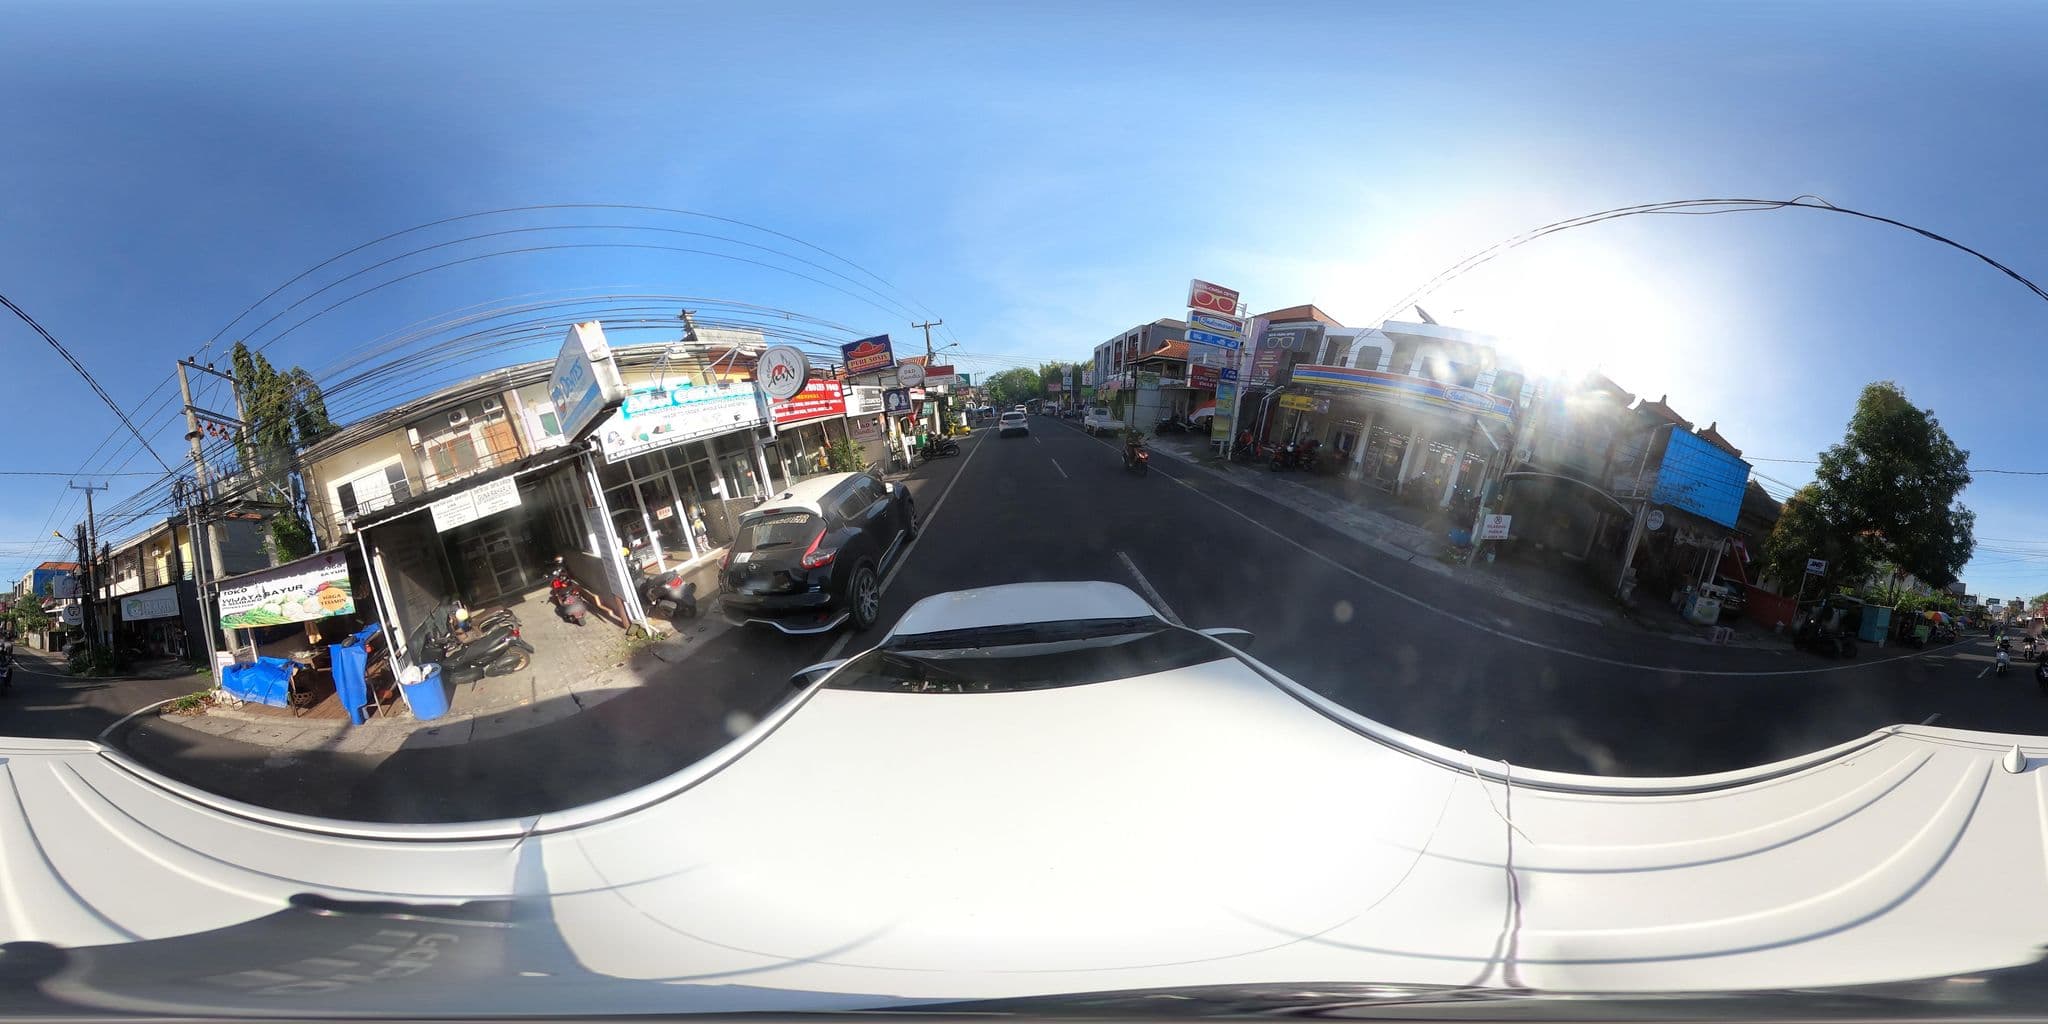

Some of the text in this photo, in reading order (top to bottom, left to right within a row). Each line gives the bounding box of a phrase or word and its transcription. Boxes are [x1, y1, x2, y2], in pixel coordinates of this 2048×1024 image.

[223, 587, 248, 596] TOKO
[263, 584, 304, 598] SAYUR
[262, 933, 460, 994] GoPro
